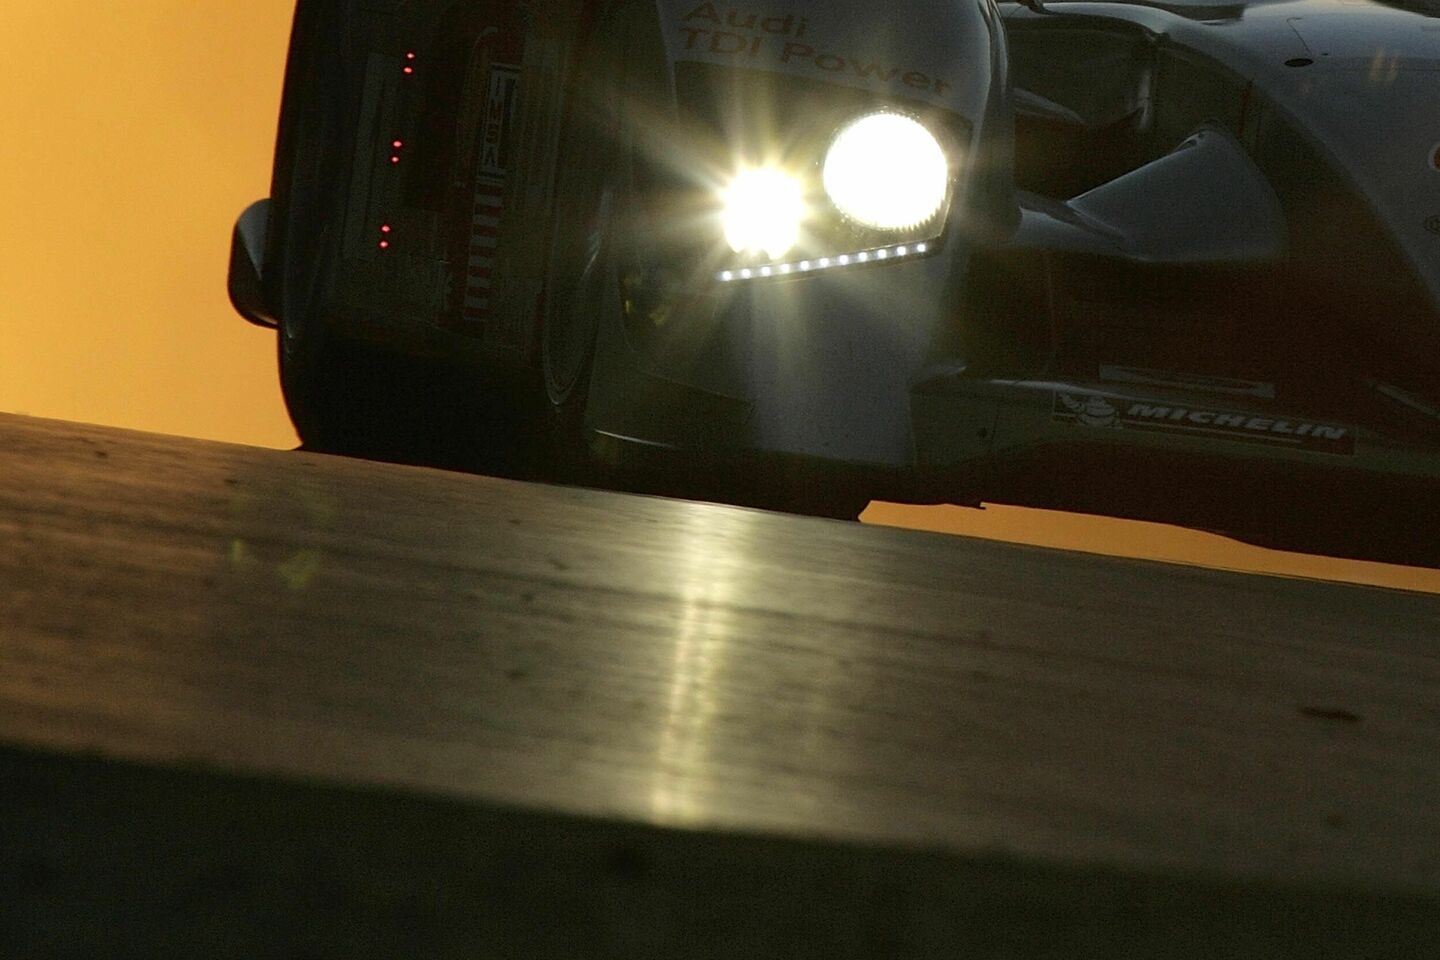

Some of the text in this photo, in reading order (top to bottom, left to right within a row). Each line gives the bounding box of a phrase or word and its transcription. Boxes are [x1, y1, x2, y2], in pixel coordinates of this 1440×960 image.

[680, 0, 809, 37] Audi
[679, 27, 952, 96] TDI Power
[1127, 403, 1347, 441] MICHELIN
